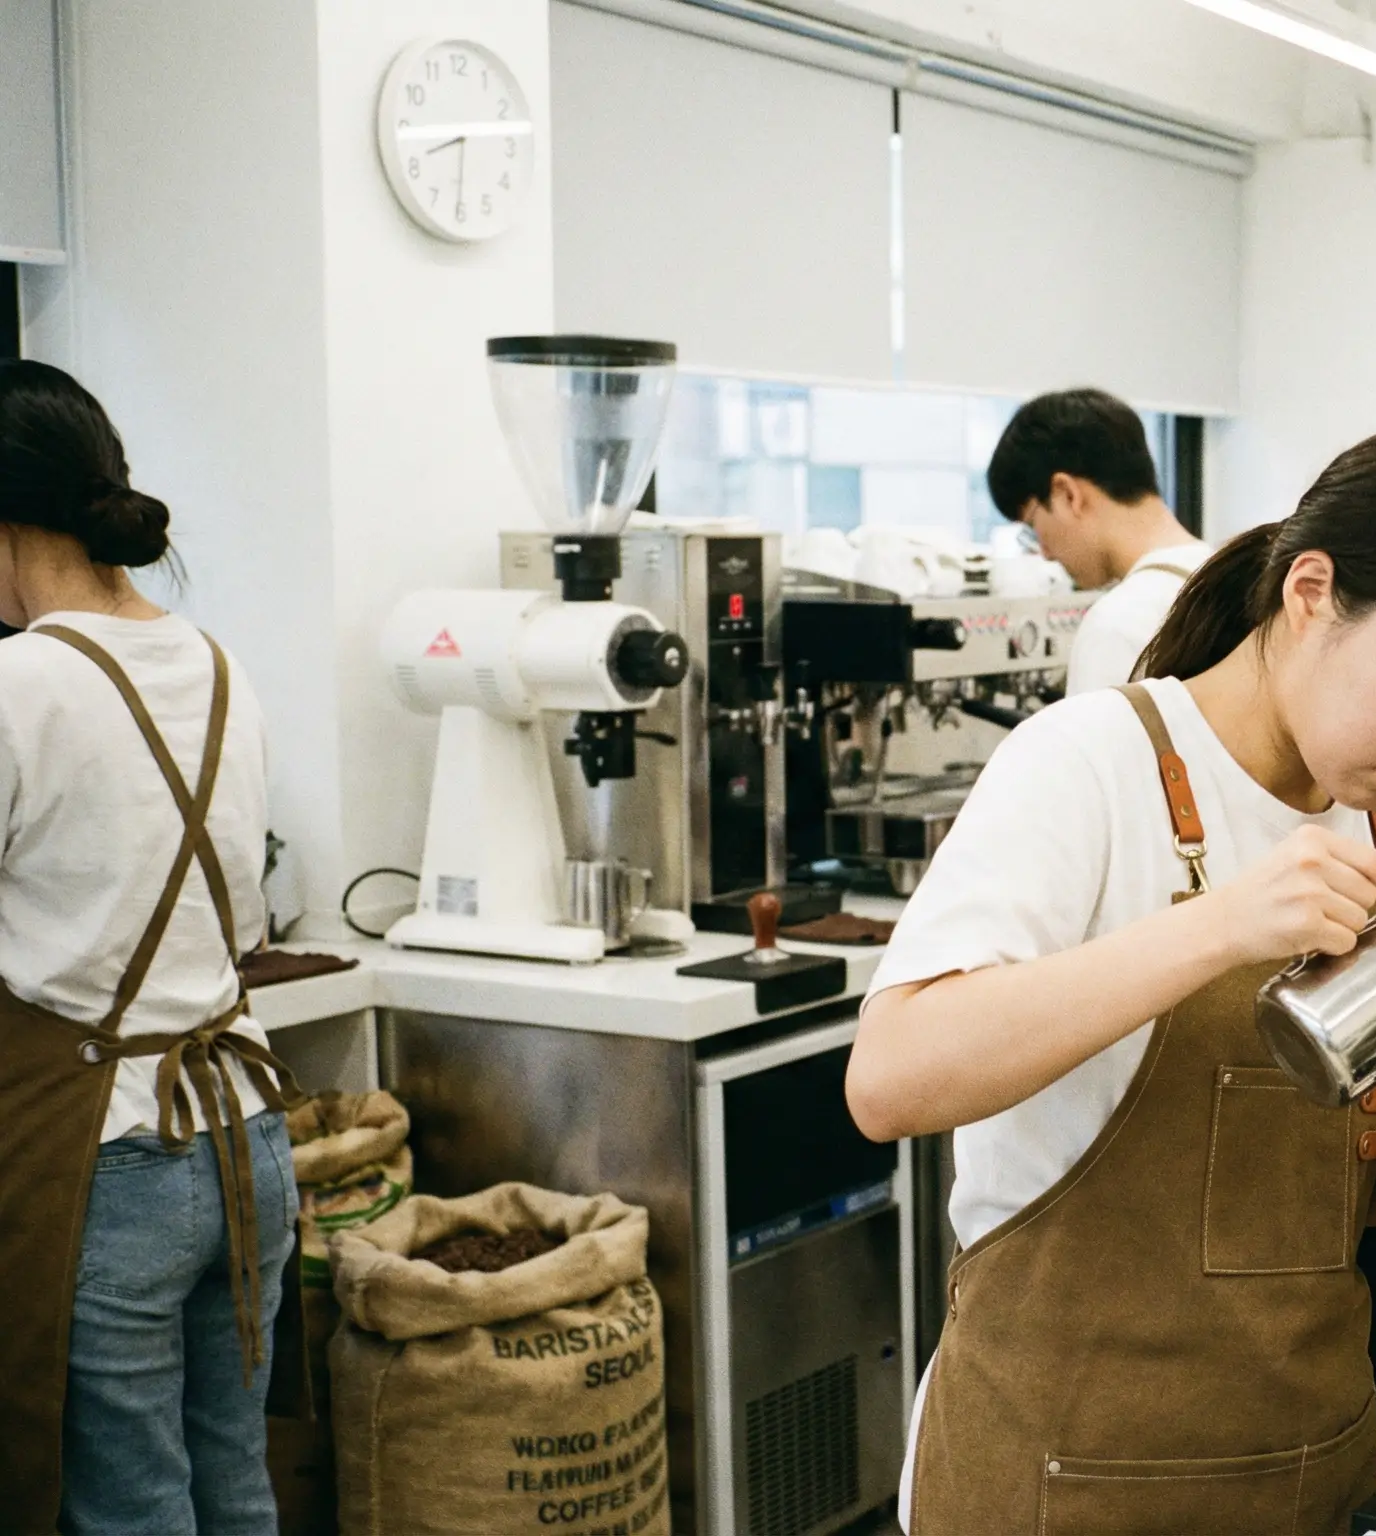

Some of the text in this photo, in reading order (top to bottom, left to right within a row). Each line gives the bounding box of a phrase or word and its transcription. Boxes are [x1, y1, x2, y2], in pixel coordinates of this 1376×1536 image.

[425, 59, 439, 82] 11
[449, 53, 469, 77] 12
[480, 69, 488, 92] 1
[406, 83, 425, 107] 10
[497, 98, 509, 121] 2
[505, 136, 517, 159] 3
[408, 156, 420, 179] 8
[498, 171, 510, 191] 4
[428, 186, 439, 208] 7
[480, 193, 492, 216] 5
[455, 200, 466, 224] 6
[491, 1323, 624, 1361] BARISTA
[584, 1338, 656, 1389] SEOUL
[538, 1480, 636, 1524] COFFEE
